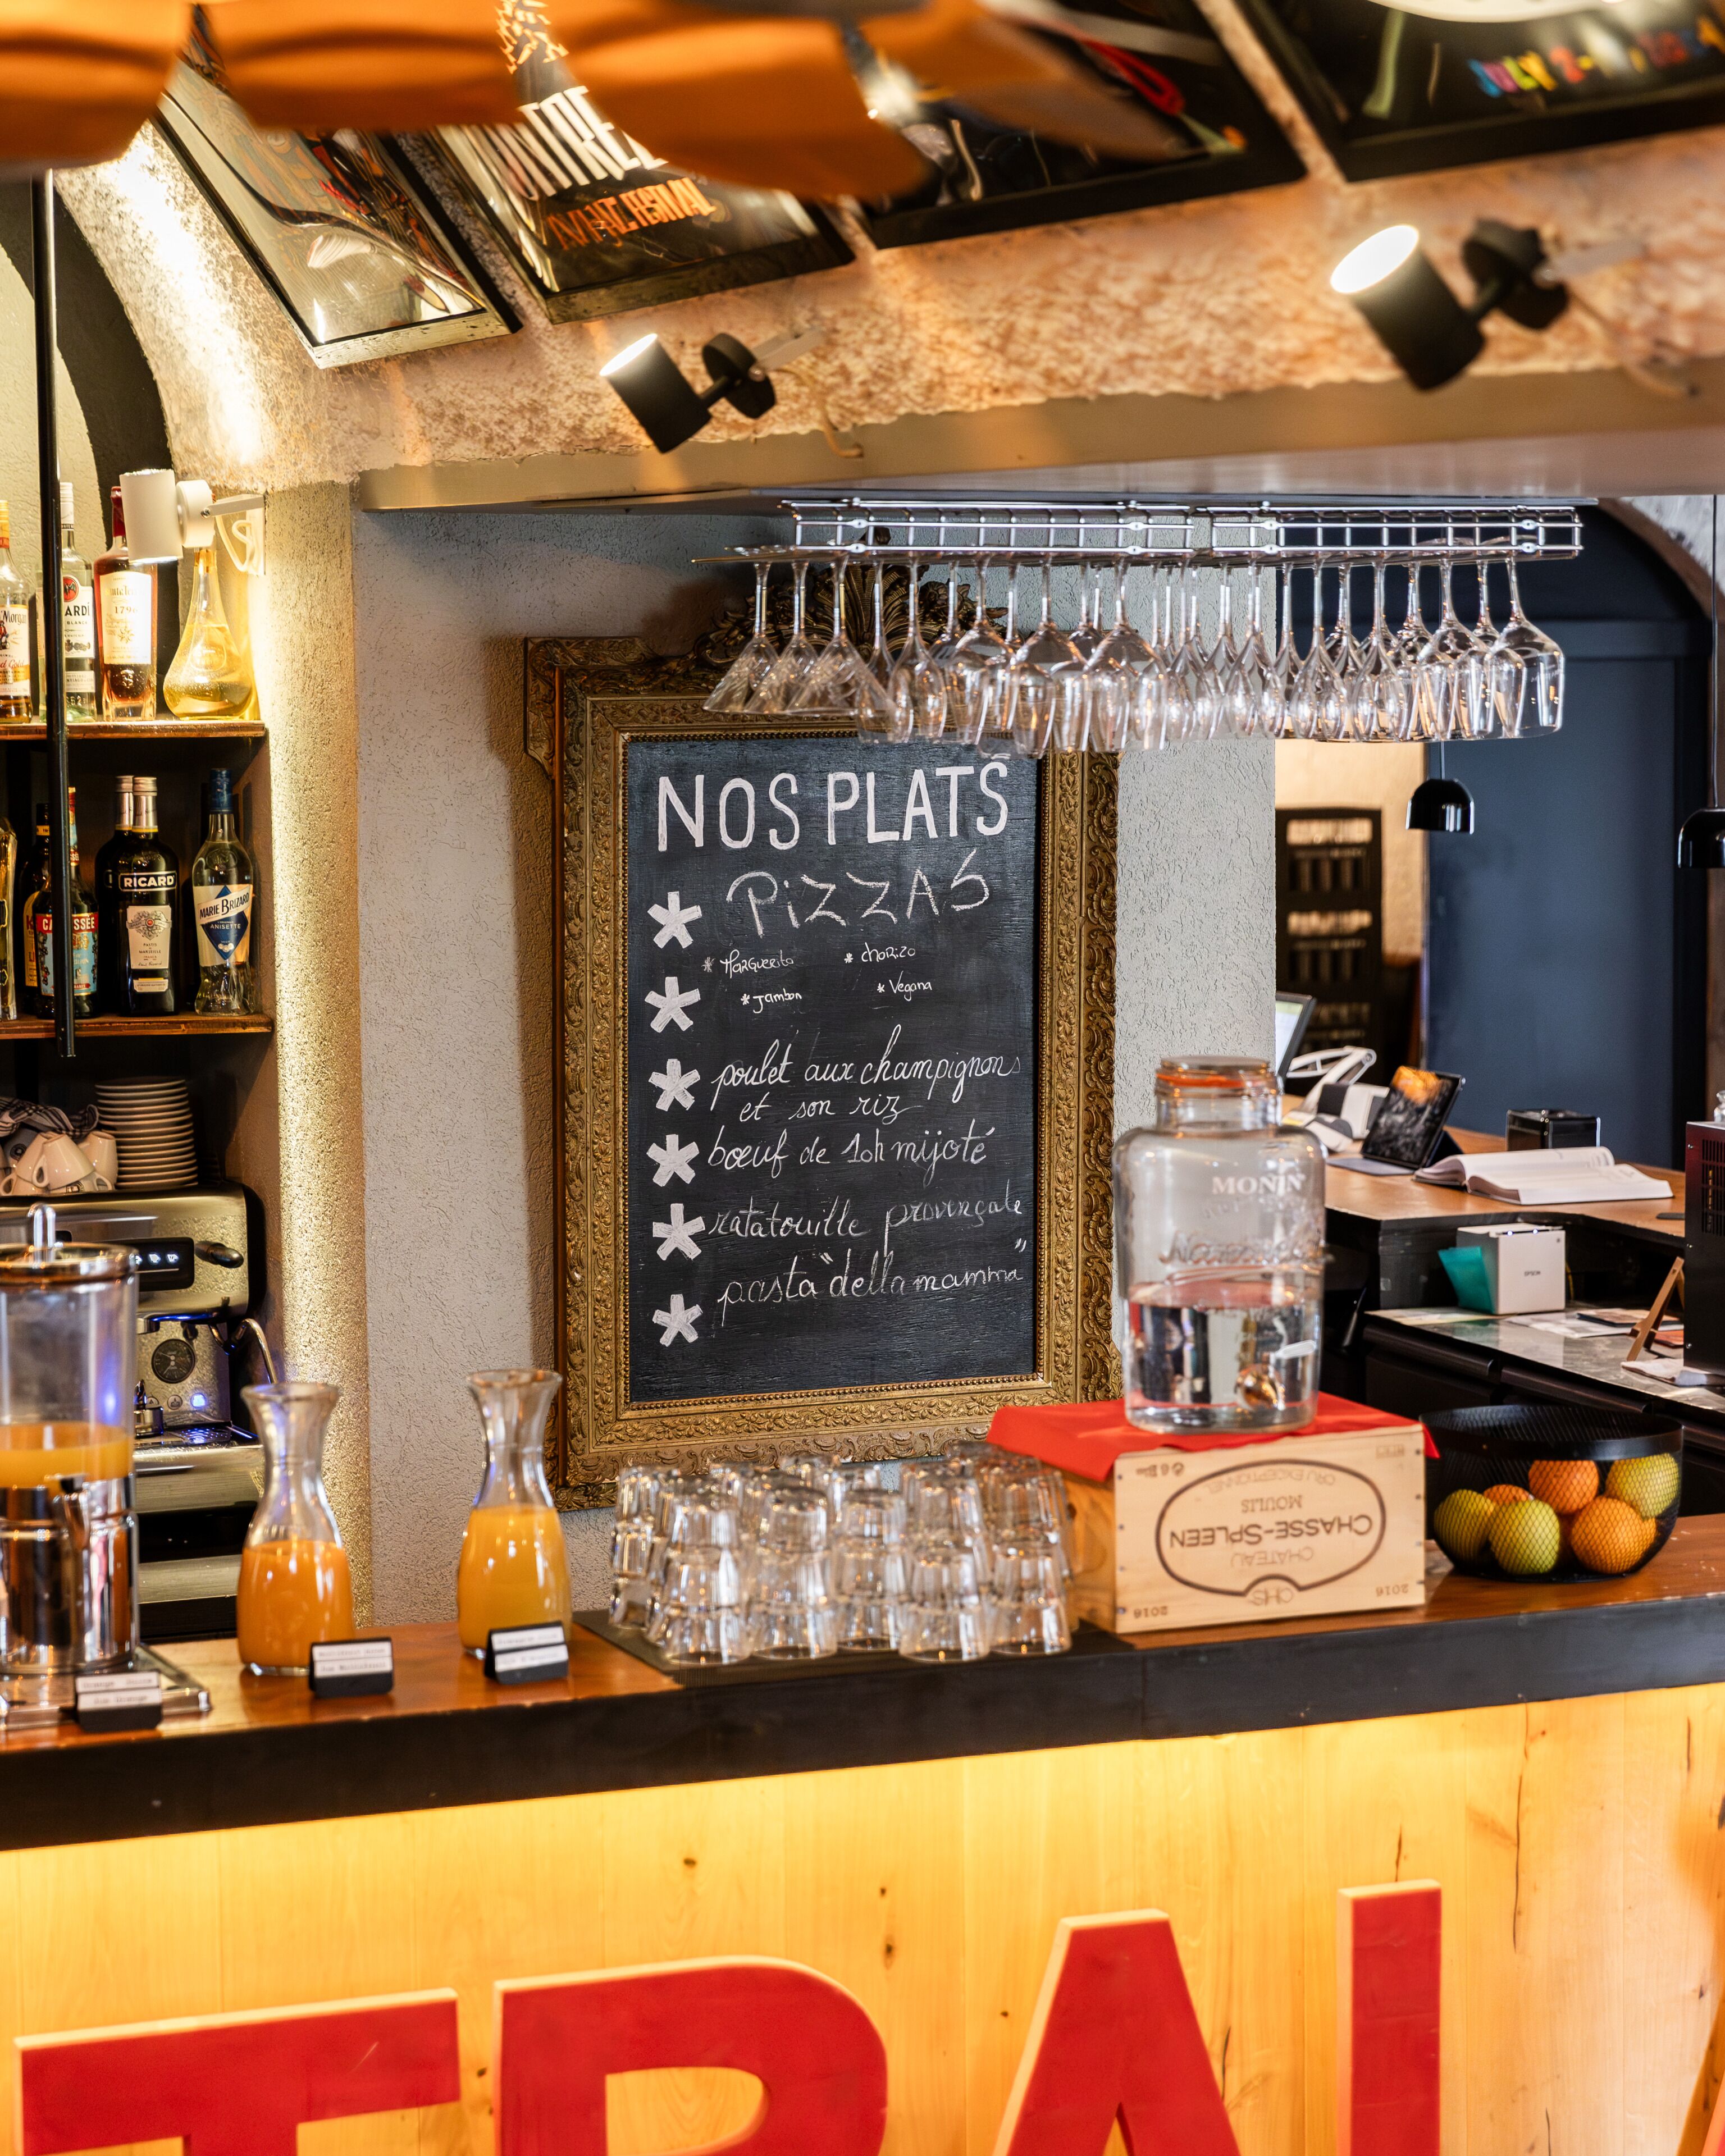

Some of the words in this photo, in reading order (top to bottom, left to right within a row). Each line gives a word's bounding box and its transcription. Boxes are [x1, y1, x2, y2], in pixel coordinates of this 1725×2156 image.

[2, 610, 27, 625] Morgan
[65, 602, 90, 616] ARDÍ
[658, 773, 800, 851] NOS
[828, 762, 1008, 845] PLATS
[124, 875, 174, 888] RICARD
[199, 904, 220, 920] MARIE
[221, 892, 249, 916] BRIZARD
[888, 970, 933, 1002] Vegana
[710, 1039, 791, 1111] poulet
[804, 1061, 854, 1083] aux
[860, 1024, 1021, 1103] champignons
[740, 1092, 770, 1122] et
[788, 1098, 836, 1120] son
[849, 1094, 924, 1125] riz
[800, 1136, 831, 1165] de
[891, 1118, 996, 1189] mijoté
[1212, 1173, 1303, 1196] MONIN
[708, 1195, 871, 1239] ratatouille
[717, 1255, 819, 1327] pasta
[1240, 1494, 1303, 1513] MOULIS
[1170, 1514, 1373, 1549] CHASSE-SPLEEN
[1376, 1583, 1409, 1597] 2016
[1133, 1606, 1169, 1619] 2016
